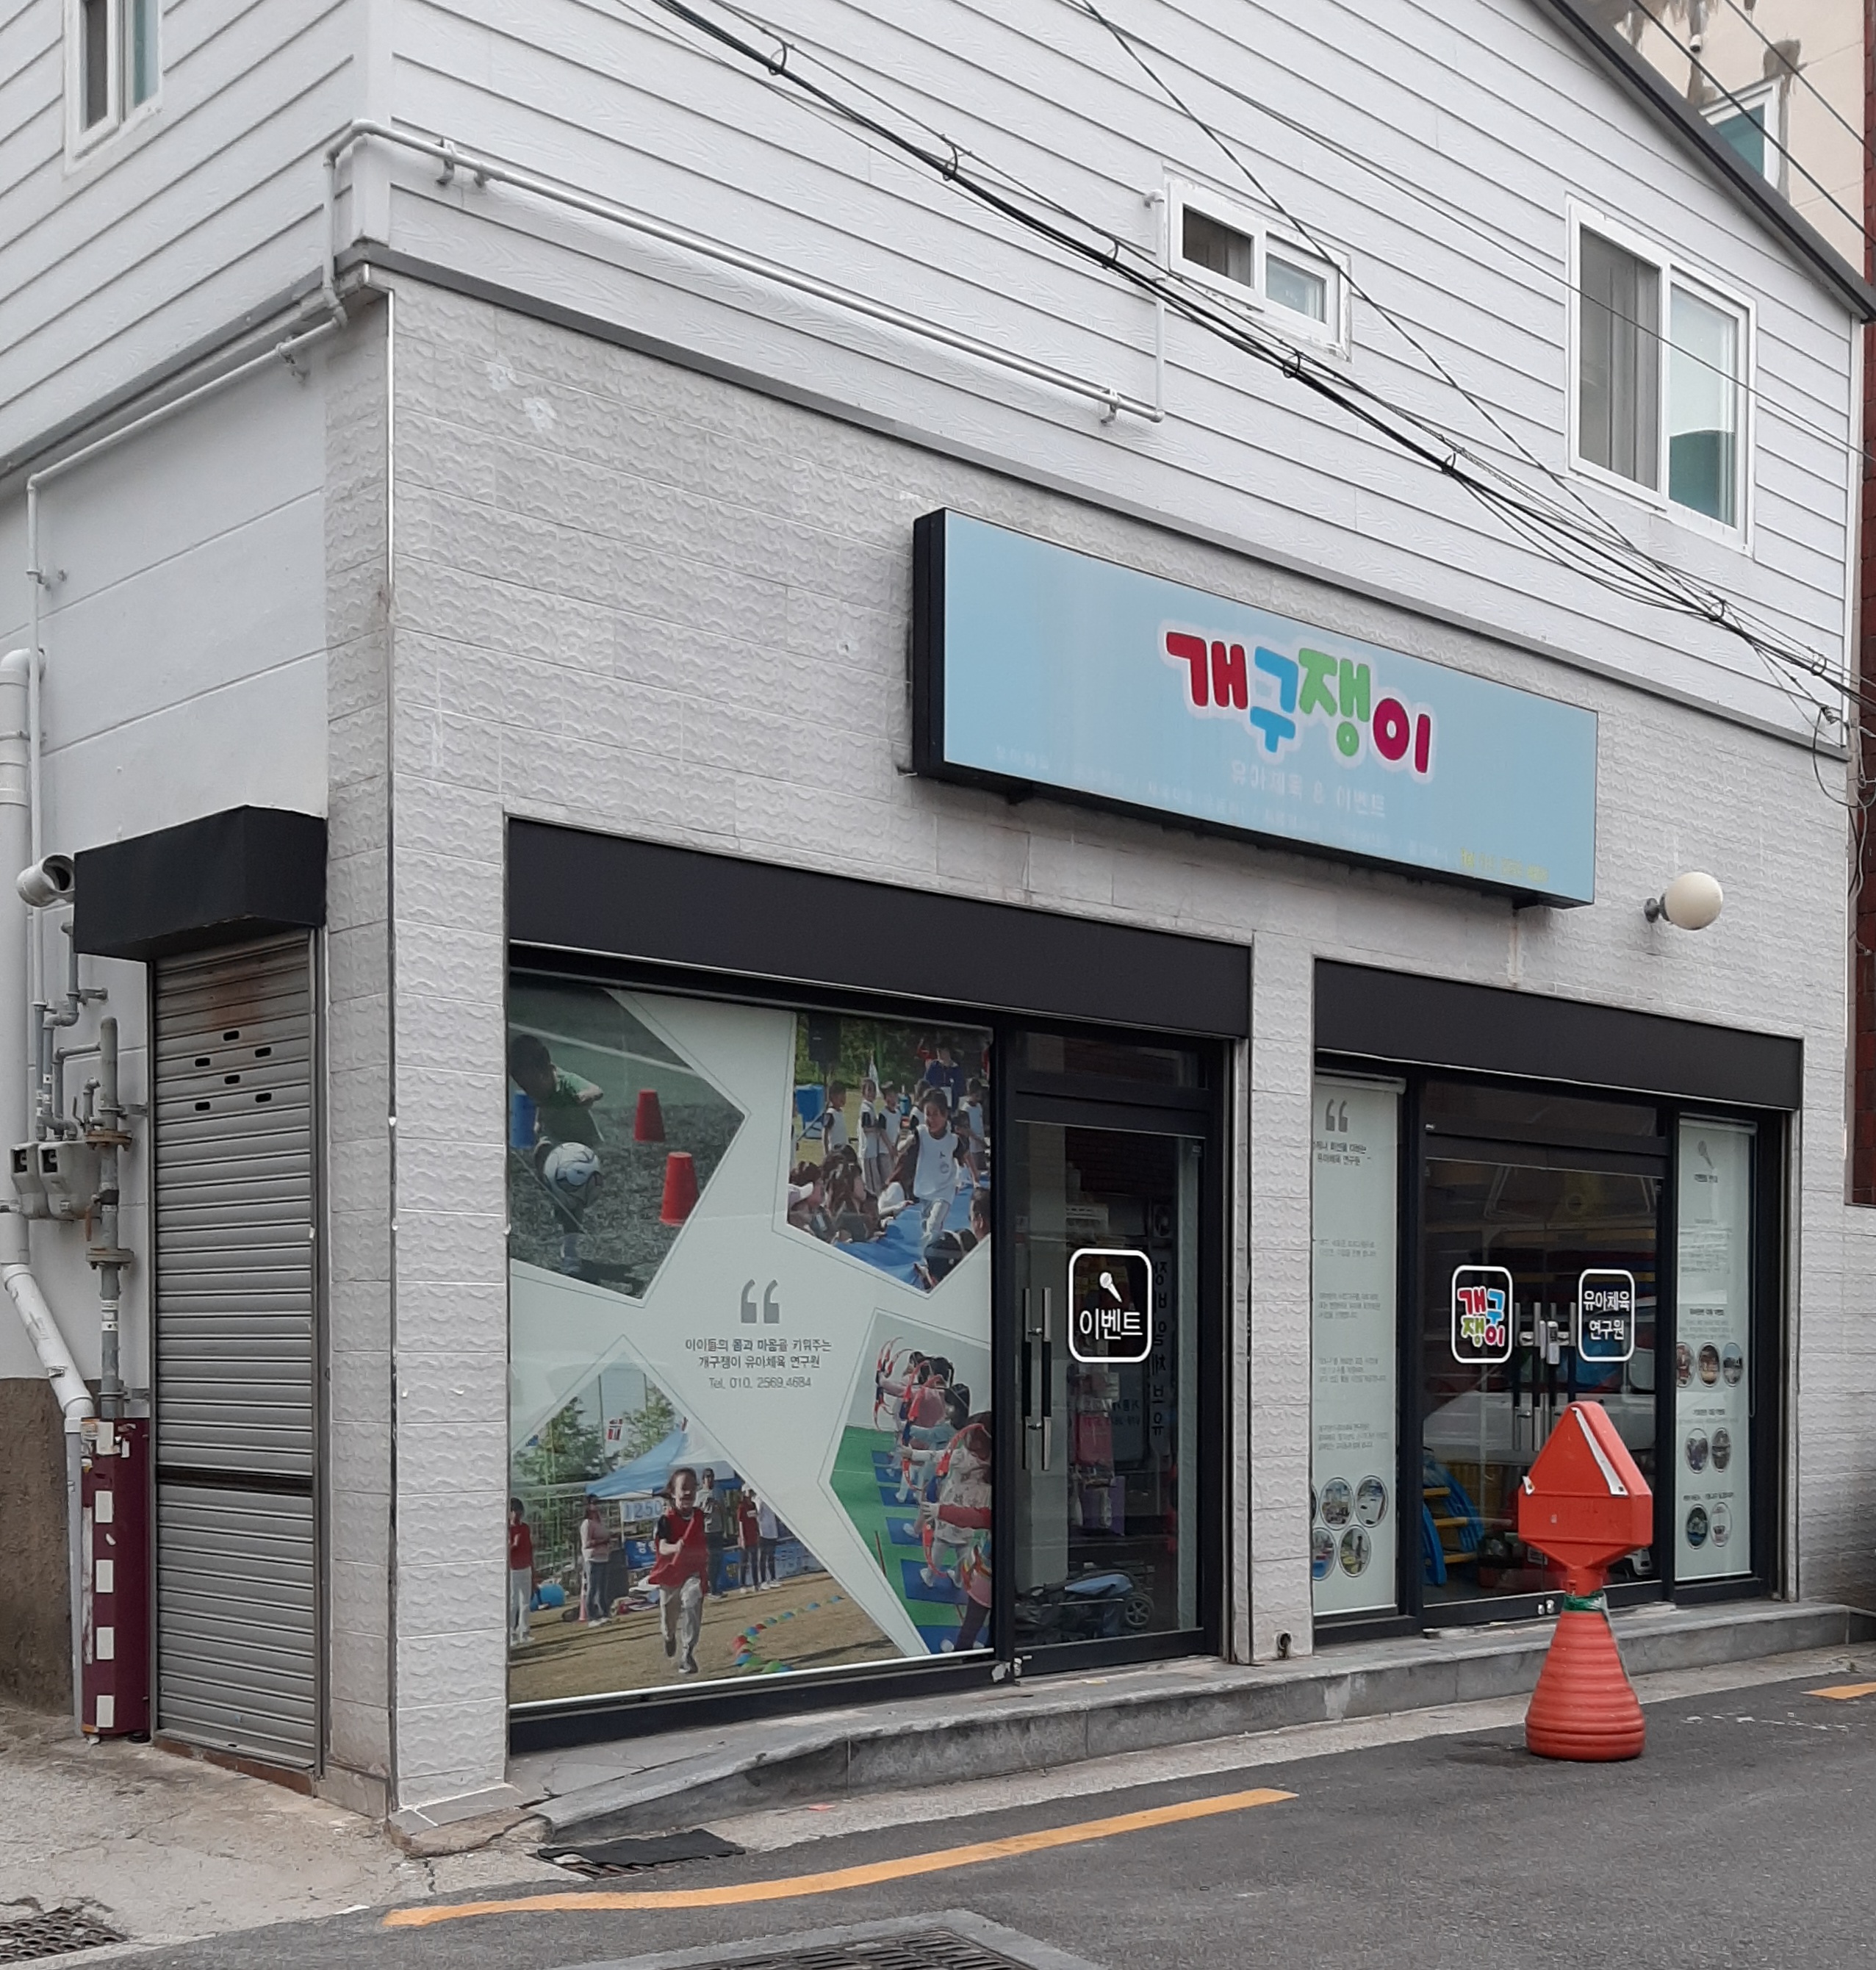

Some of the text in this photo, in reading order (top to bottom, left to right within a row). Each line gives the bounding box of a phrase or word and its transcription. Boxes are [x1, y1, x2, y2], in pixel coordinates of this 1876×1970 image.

[1162, 627, 1434, 777] 개구쟁이
[1457, 1286, 1506, 1325] 개구
[1583, 1290, 1631, 1312] 유아체육
[1079, 1308, 1143, 1340] 이벤트
[1461, 1315, 1506, 1348] 쟁이
[1589, 1320, 1625, 1341] 연구원
[685, 1338, 729, 1353] 아이들의
[757, 1338, 788, 1353] 마음을
[792, 1338, 833, 1353] 키워주는
[698, 1355, 821, 1369] 개구쟁이 유아체육 연구원
